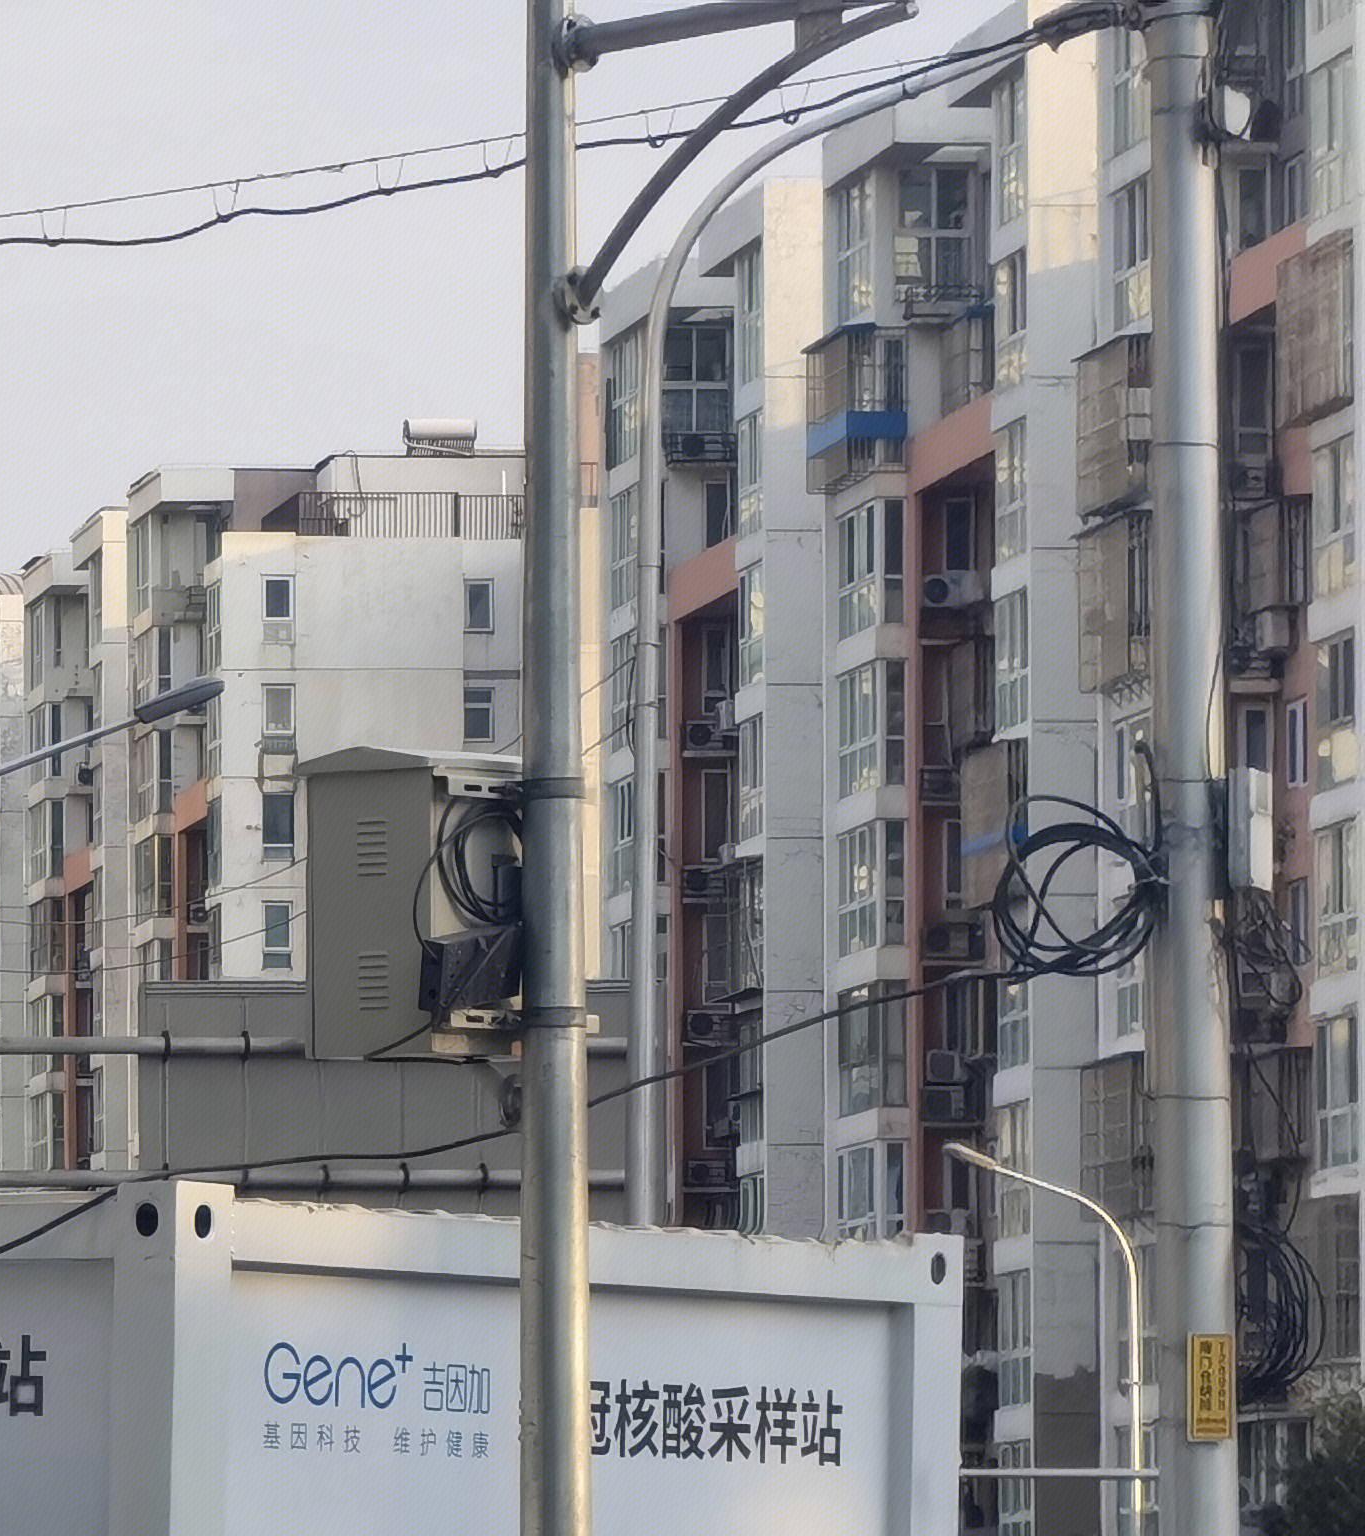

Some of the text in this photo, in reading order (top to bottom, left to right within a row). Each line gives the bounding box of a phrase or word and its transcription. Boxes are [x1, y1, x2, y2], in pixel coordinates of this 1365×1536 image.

[423, 1361, 490, 1414] 吉因加
[263, 1421, 490, 1460] 基因科技 维护健康
